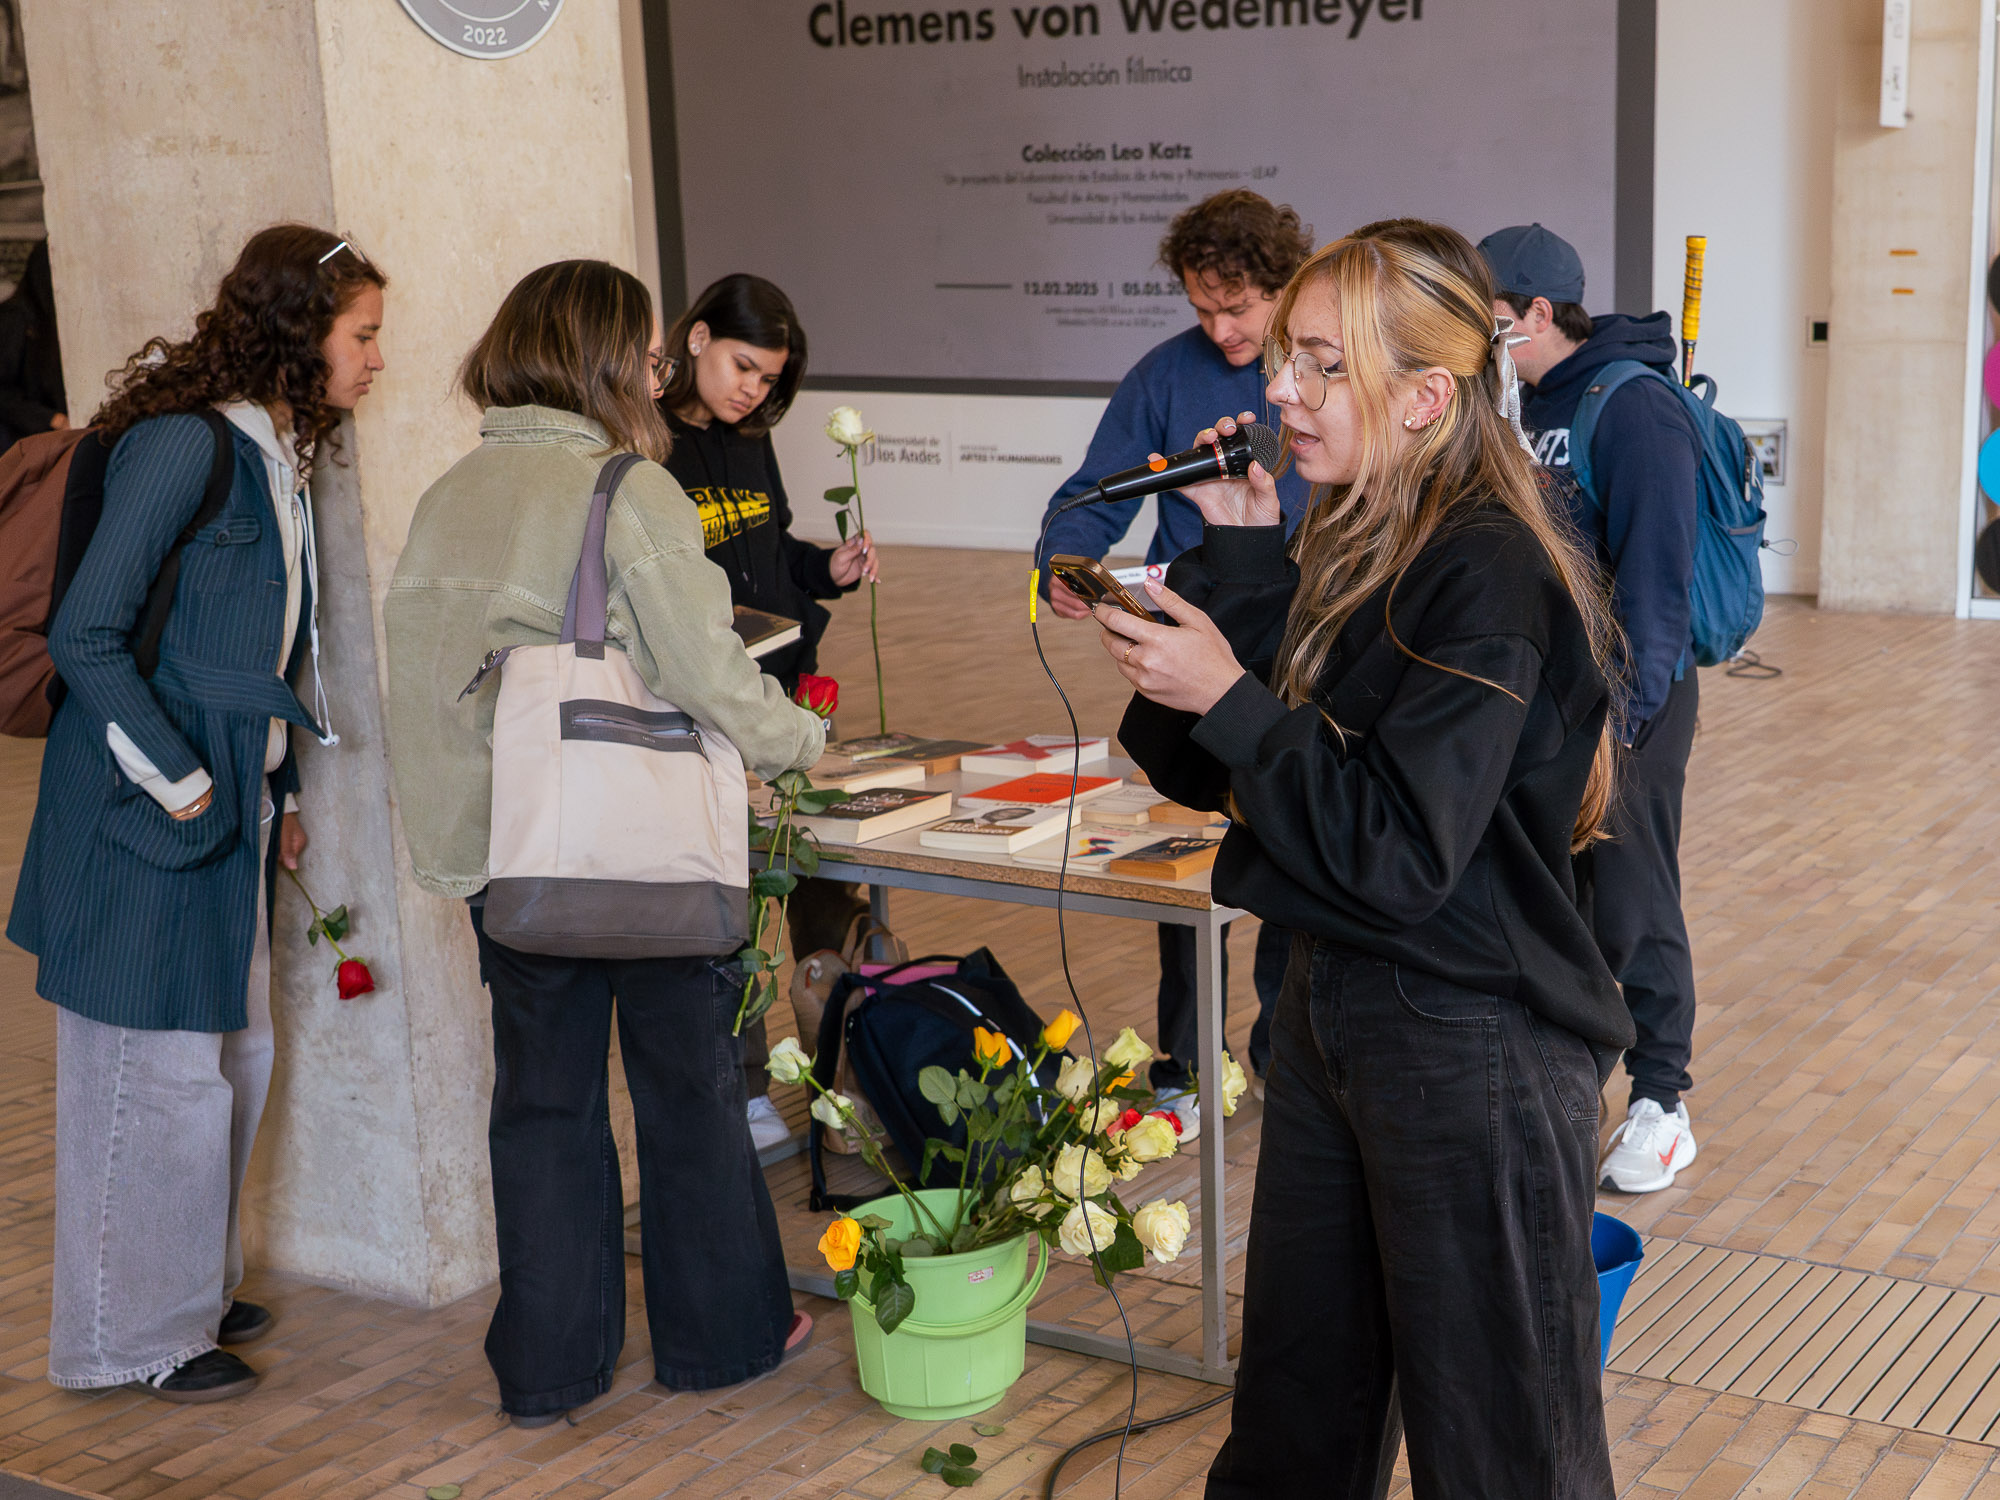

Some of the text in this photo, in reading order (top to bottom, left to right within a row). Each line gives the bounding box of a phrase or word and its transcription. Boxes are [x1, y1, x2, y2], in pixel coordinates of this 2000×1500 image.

[808, 0, 995, 47] Clemens
[1011, 3, 1100, 38] von
[462, 24, 508, 46] 2022
[1017, 59, 1120, 88] Instalación
[1022, 141, 1193, 163] Colección Leo Katz
[878, 446, 941, 466] los Andes
